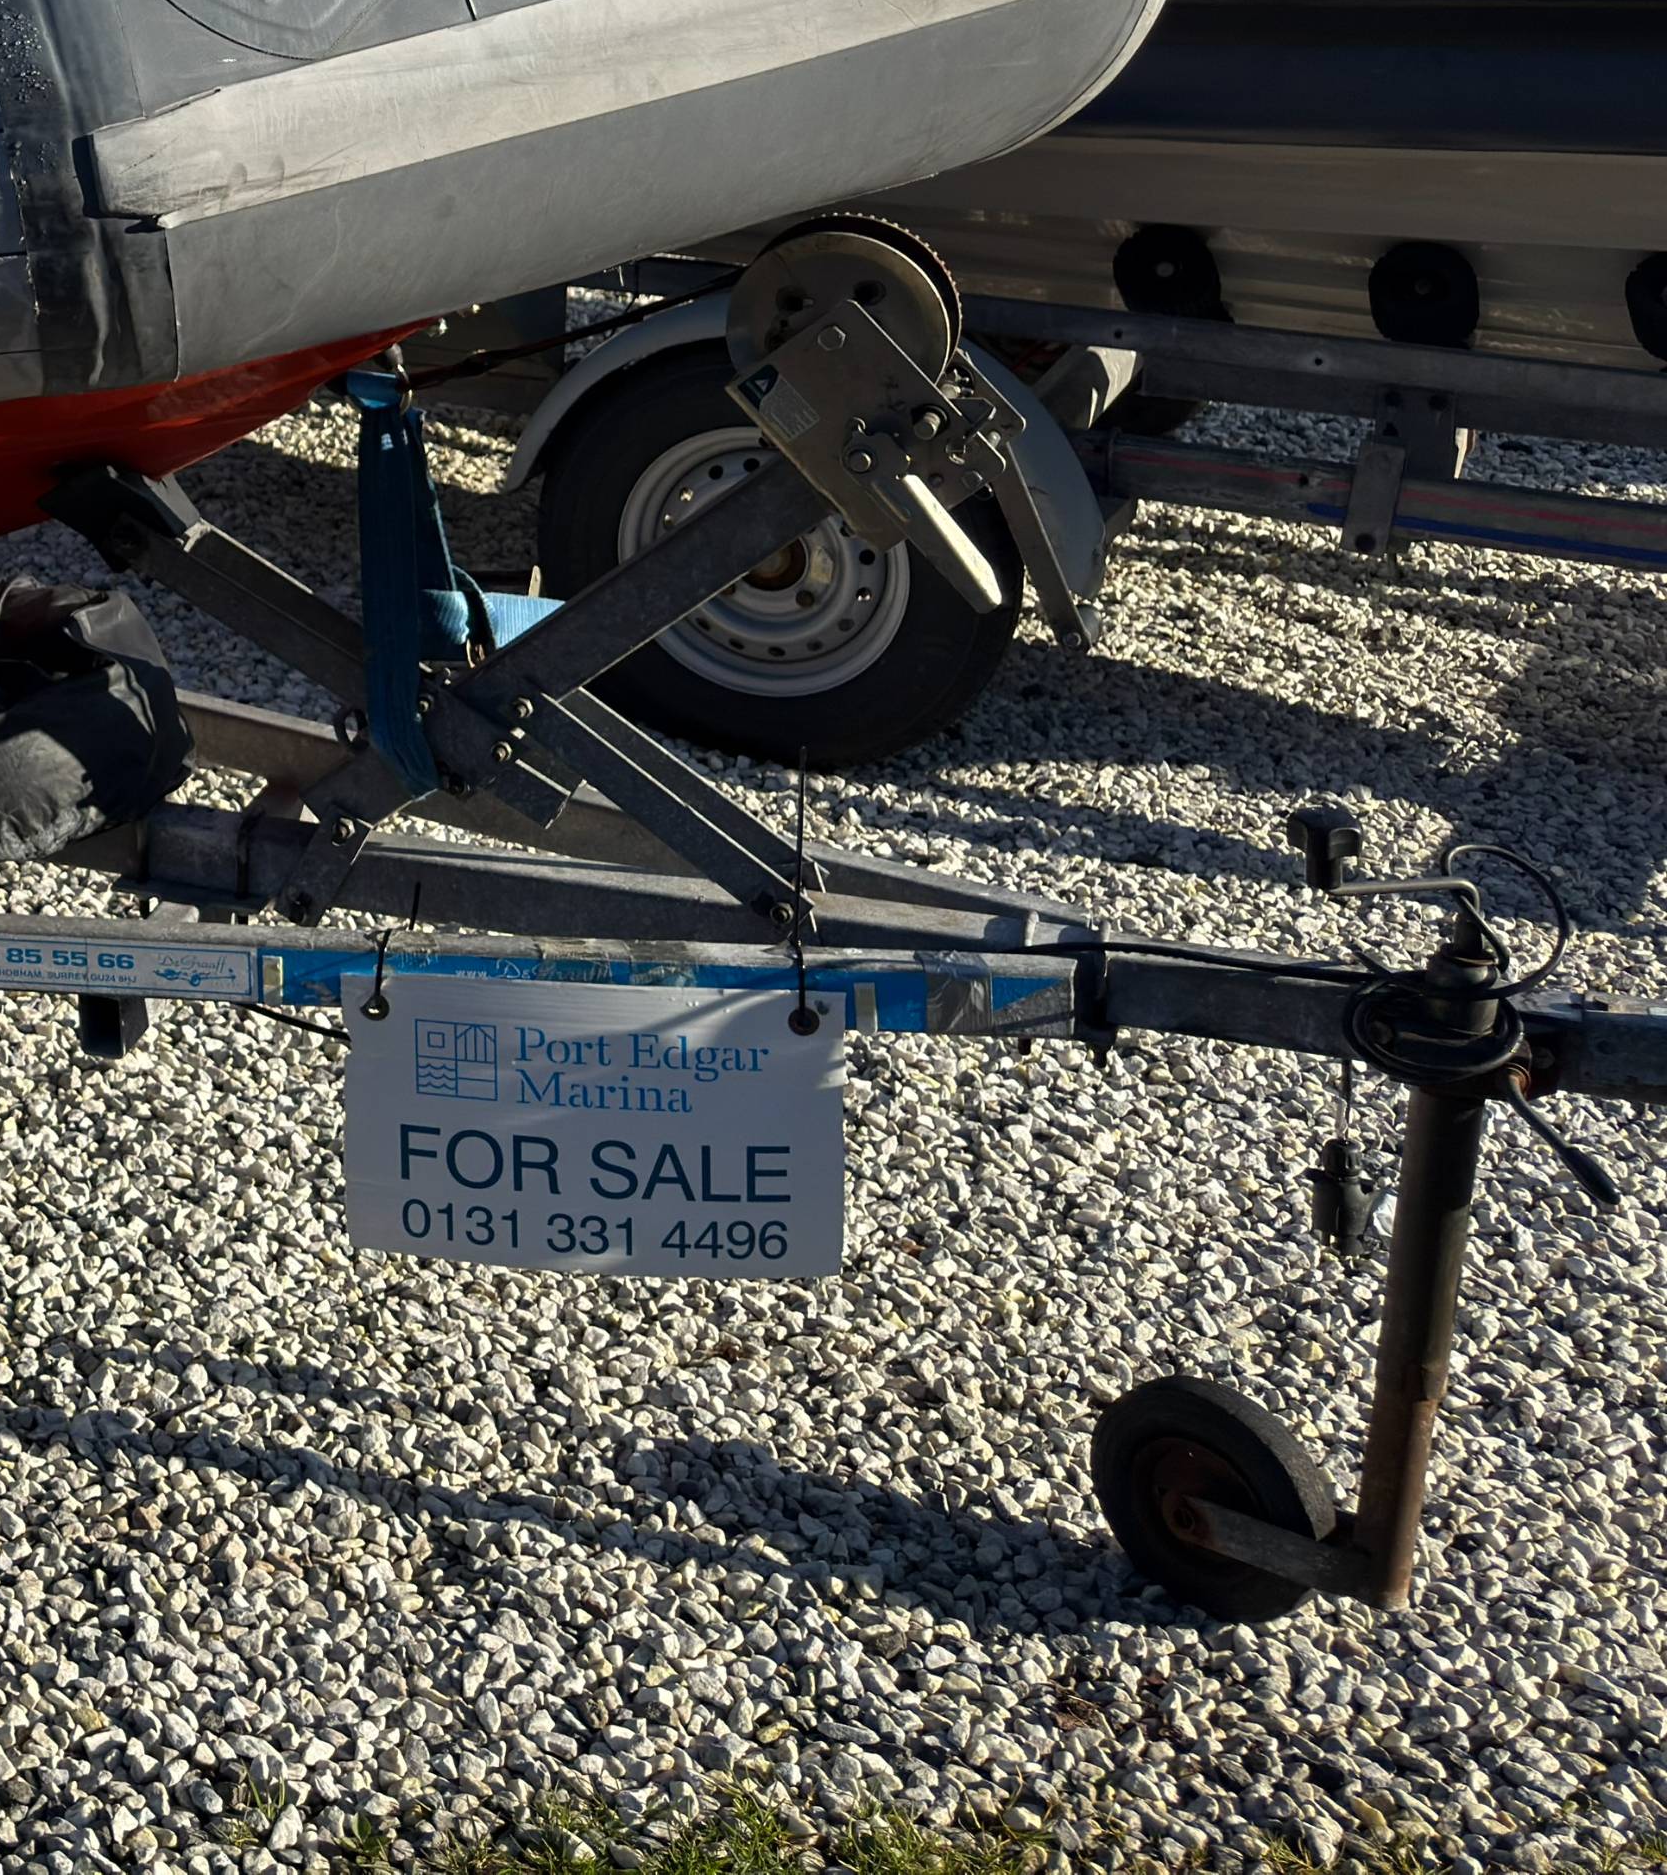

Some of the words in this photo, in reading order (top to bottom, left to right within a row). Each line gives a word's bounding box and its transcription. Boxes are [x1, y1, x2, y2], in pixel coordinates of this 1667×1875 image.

[6, 947, 43, 964] 85
[52, 949, 88, 967] 55
[97, 952, 135, 969] 66
[515, 1026, 612, 1067] Port
[628, 1032, 770, 1083] Edgar
[515, 1068, 694, 1114] Marina
[399, 1123, 562, 1196] FOR
[589, 1139, 792, 1204] SALE
[401, 1198, 520, 1249] 0131
[546, 1214, 635, 1256] 331
[660, 1220, 789, 1261] 4496
